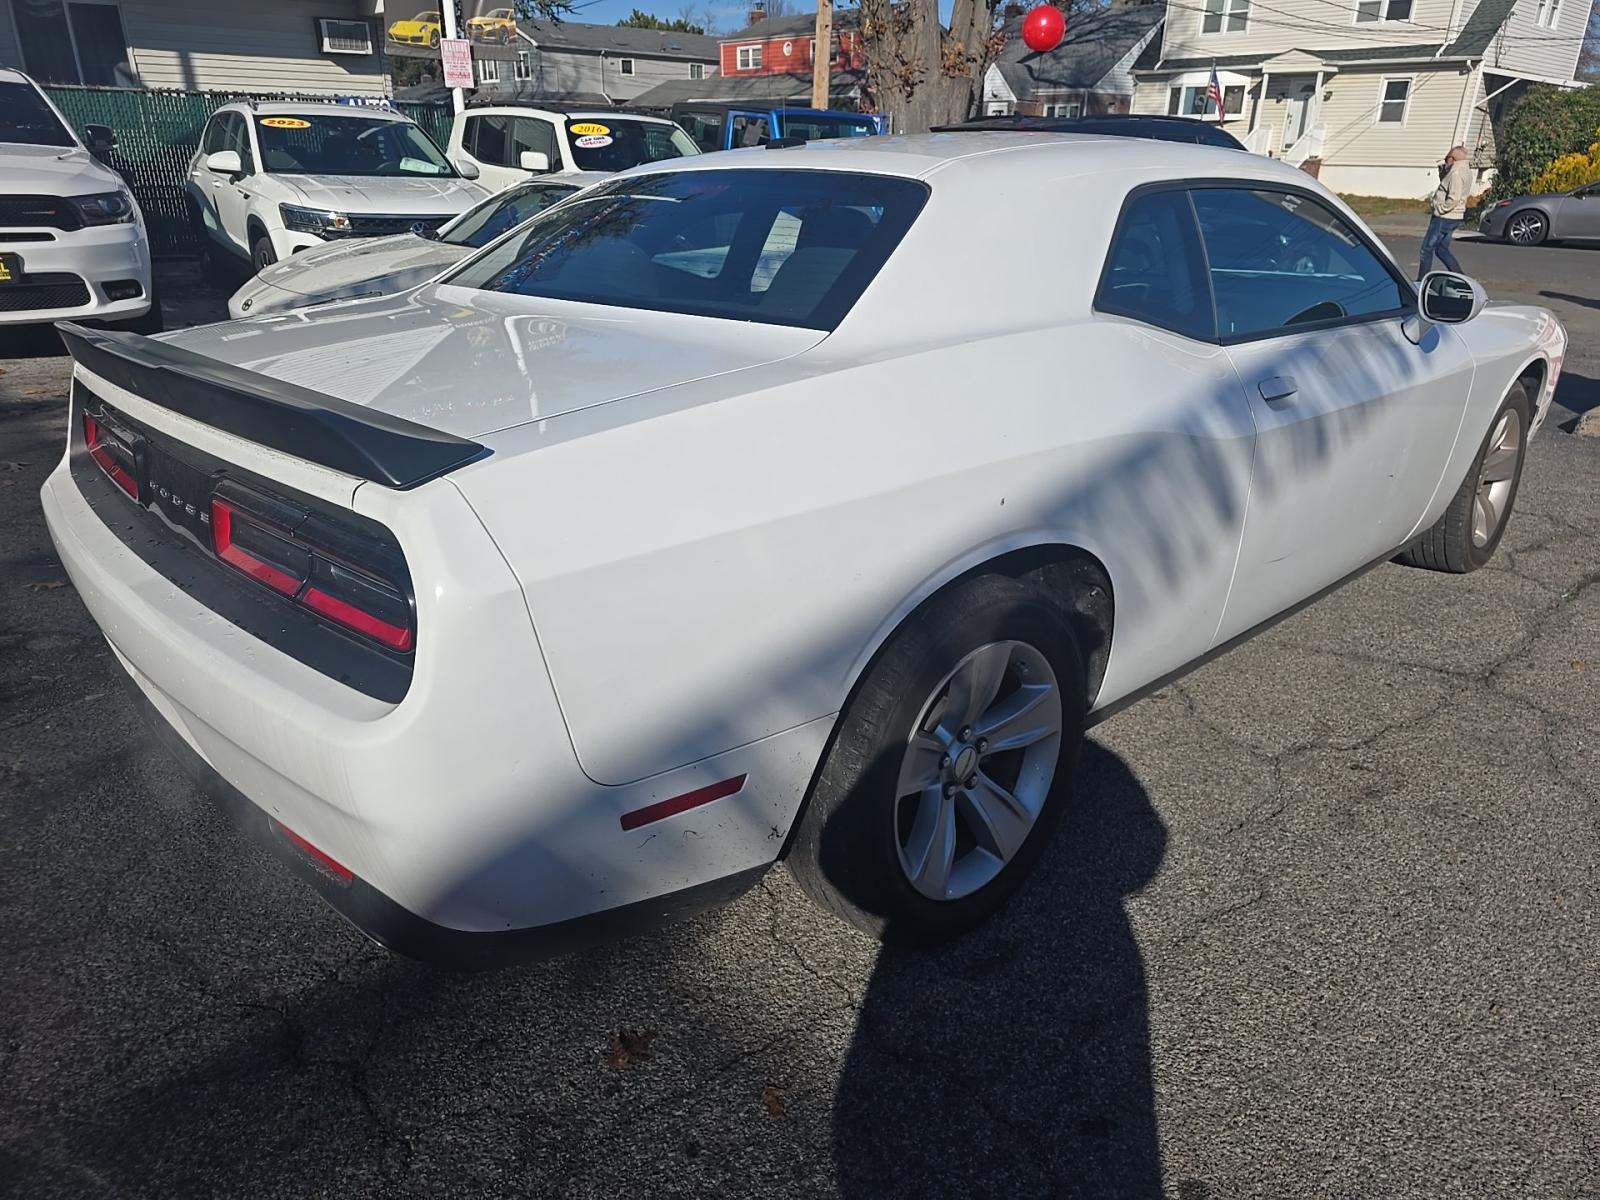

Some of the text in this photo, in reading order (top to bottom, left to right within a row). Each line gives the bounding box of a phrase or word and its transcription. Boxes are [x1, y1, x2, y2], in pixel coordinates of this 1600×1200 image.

[267, 119, 304, 127] 2023
[578, 125, 603, 133] 2016
[149, 481, 209, 524] DODGE
